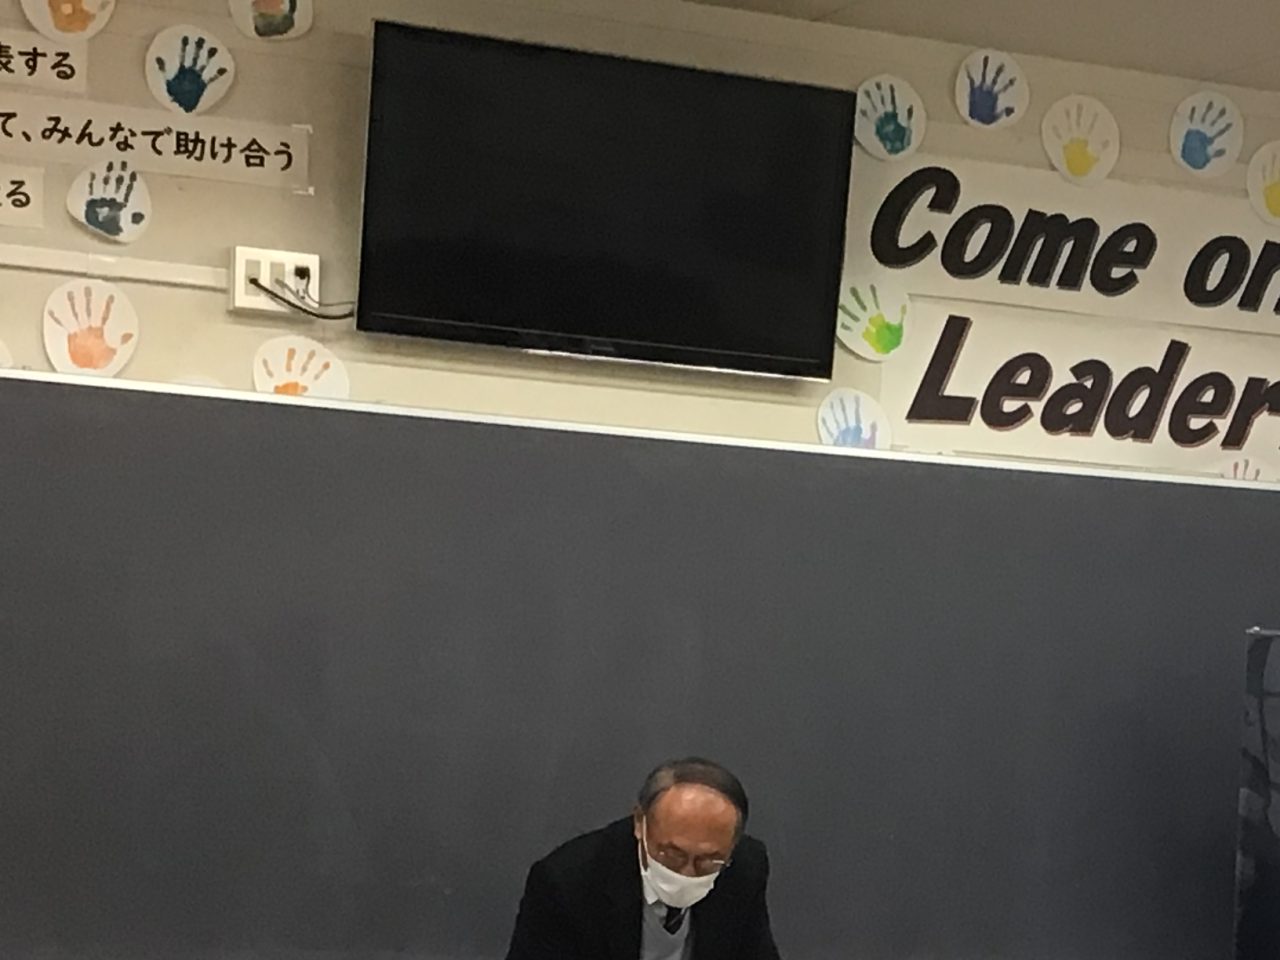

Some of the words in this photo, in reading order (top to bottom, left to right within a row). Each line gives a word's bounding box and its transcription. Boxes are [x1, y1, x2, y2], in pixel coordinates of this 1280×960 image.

[0, 112, 294, 172] て、みんなで助け合う
[0, 180, 31, 208] る
[871, 167, 1157, 297] Come
